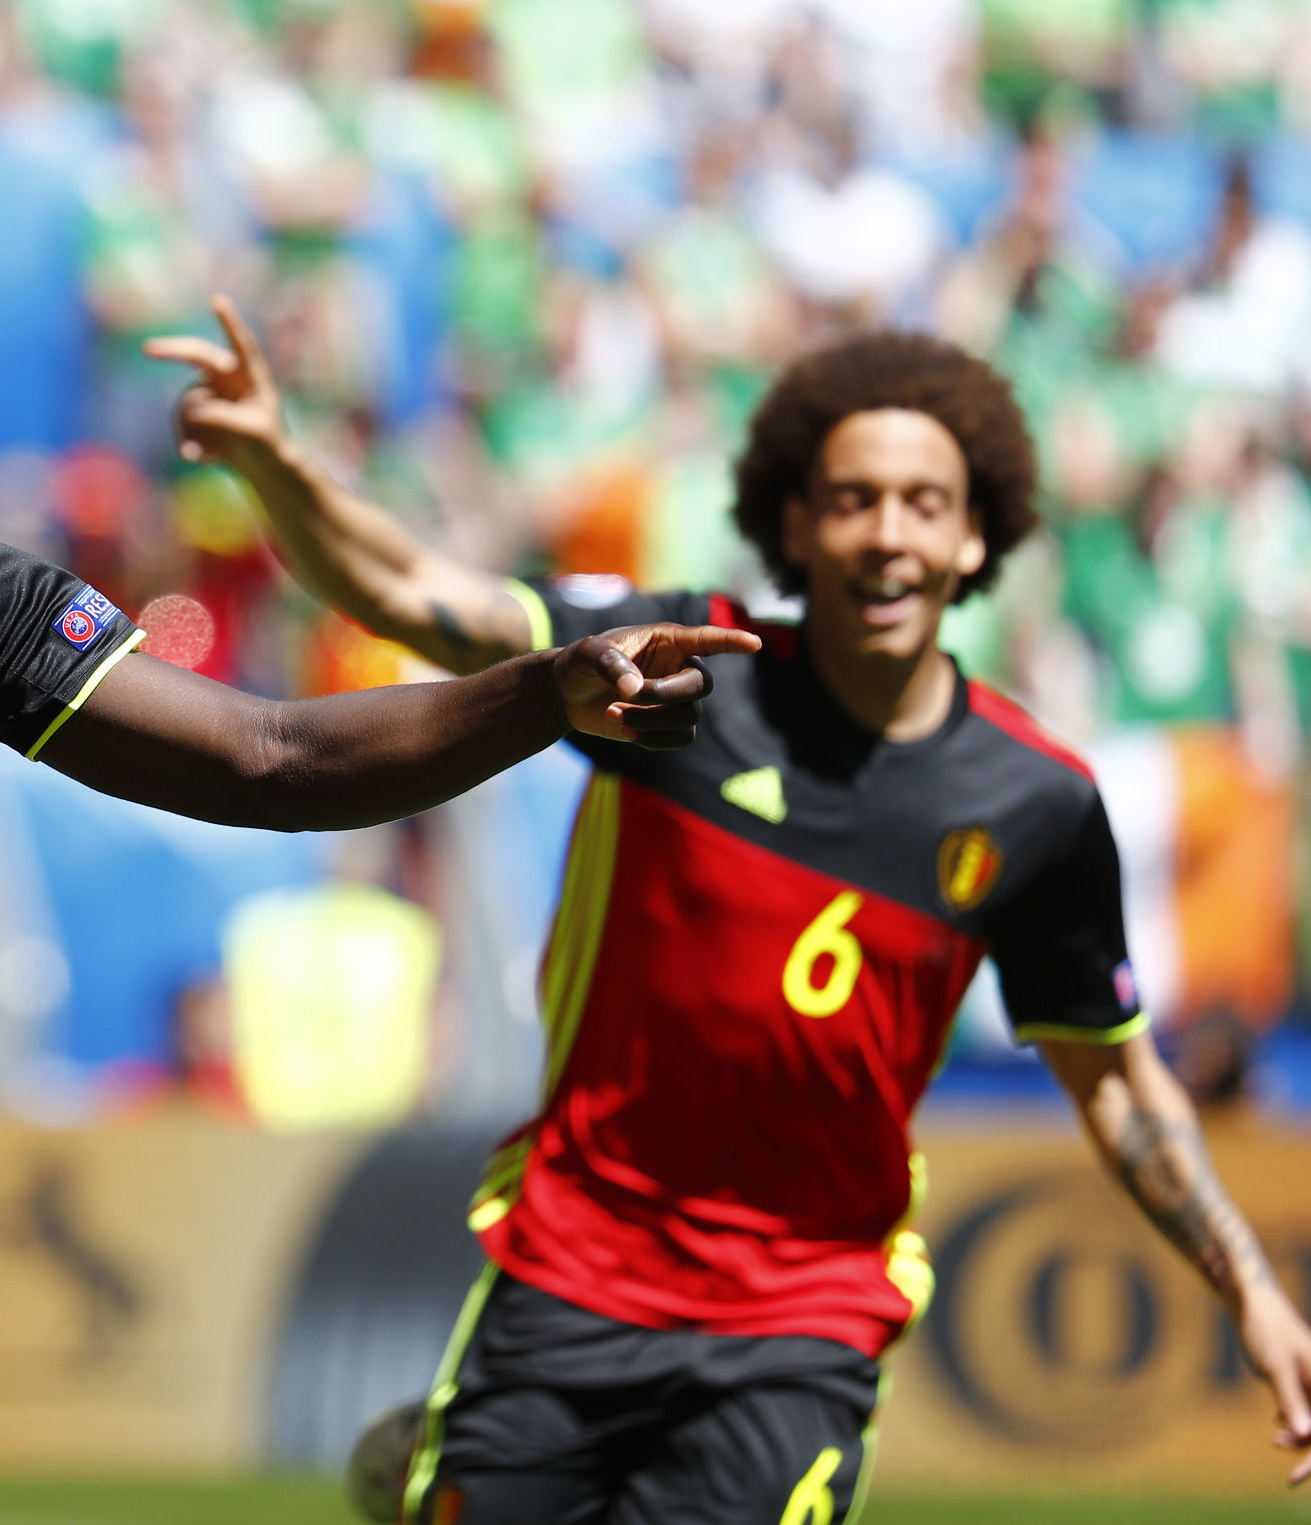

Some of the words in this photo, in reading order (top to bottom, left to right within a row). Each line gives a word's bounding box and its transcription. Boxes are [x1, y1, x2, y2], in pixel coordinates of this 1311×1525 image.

[65, 612, 80, 628] UEFA
[782, 890, 863, 1018] 6
[778, 1447, 843, 1525] 6
